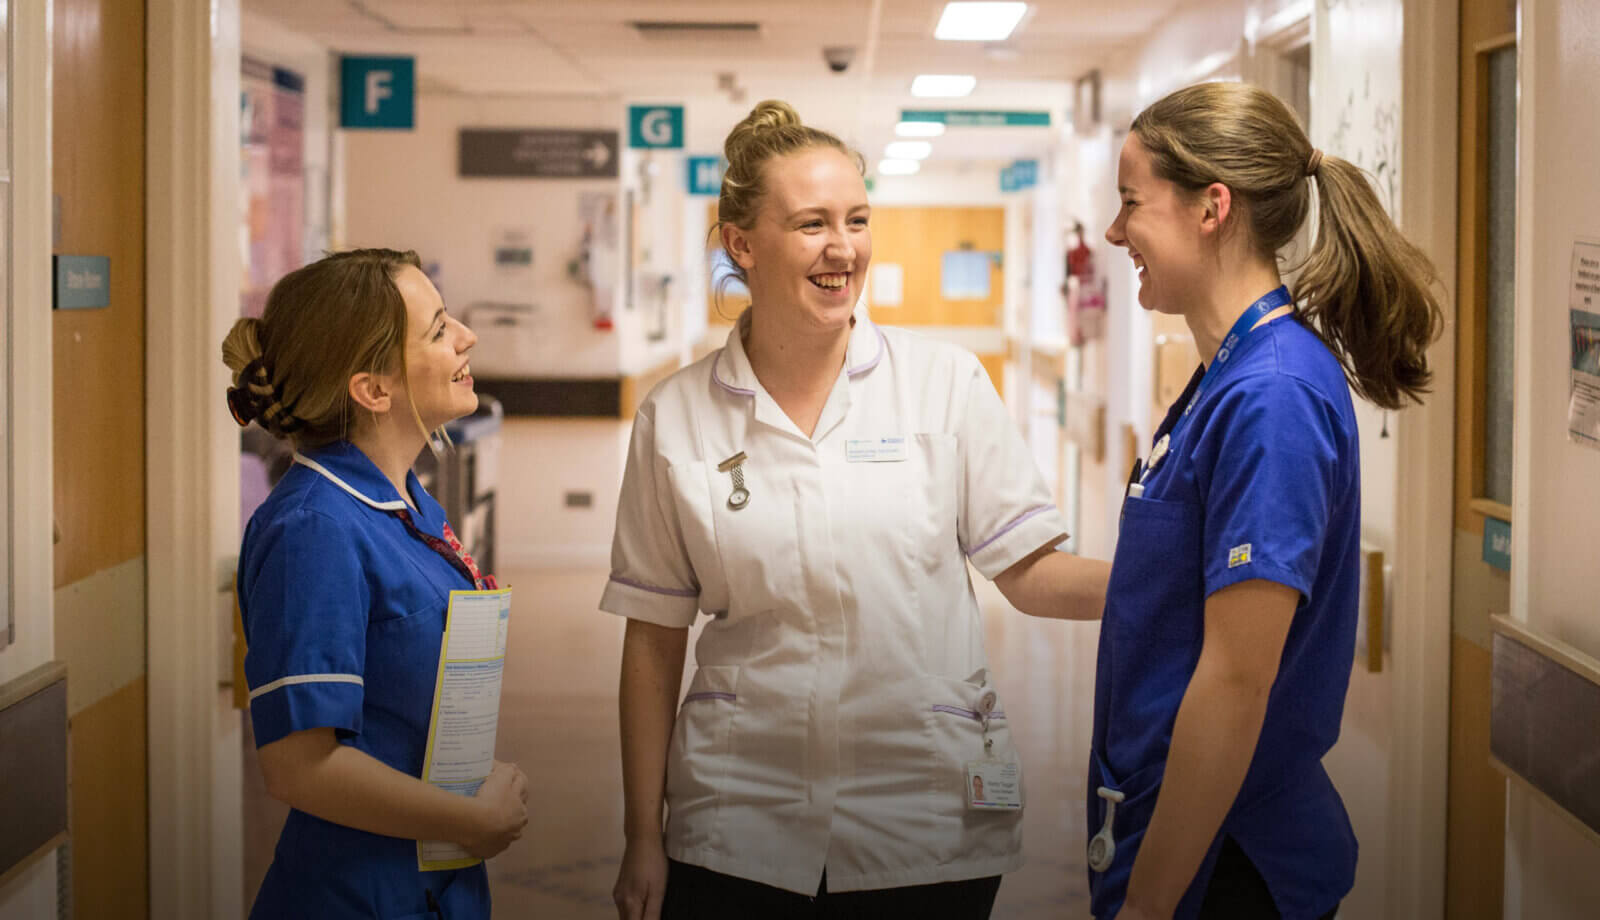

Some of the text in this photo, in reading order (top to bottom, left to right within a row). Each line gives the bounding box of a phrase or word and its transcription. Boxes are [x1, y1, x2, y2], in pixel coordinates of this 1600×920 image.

[365, 70, 394, 114] F
[641, 110, 672, 144] G
[697, 162, 721, 188] H
